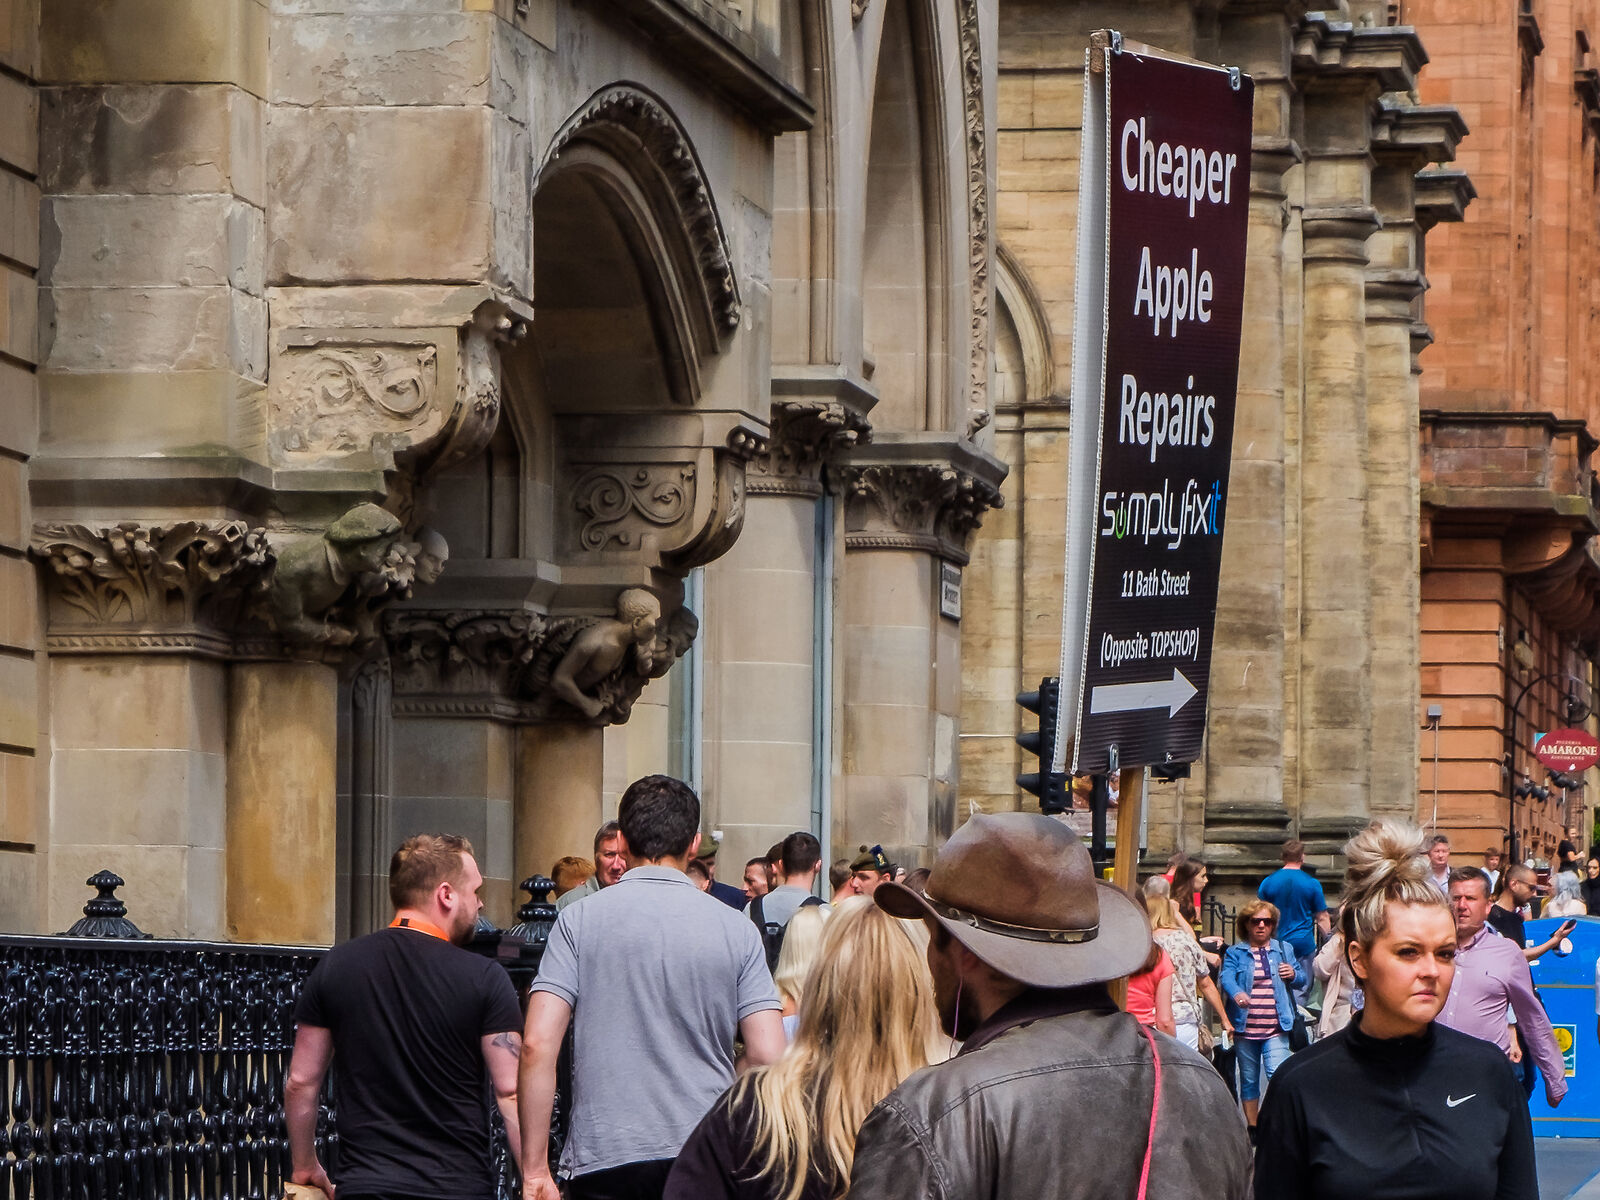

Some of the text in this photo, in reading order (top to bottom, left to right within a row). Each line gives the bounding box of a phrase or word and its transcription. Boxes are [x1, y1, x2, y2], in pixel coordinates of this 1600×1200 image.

[1120, 116, 1237, 218] Cheaper
[1133, 246, 1213, 338] Apple
[1119, 373, 1216, 463] Repairs
[1101, 478, 1222, 550] simplyfixit
[1121, 568, 1190, 597] 11 Bath Street
[1100, 627, 1200, 668] (Opposite TOPSHOP)
[1539, 745, 1598, 756] AMARONE
